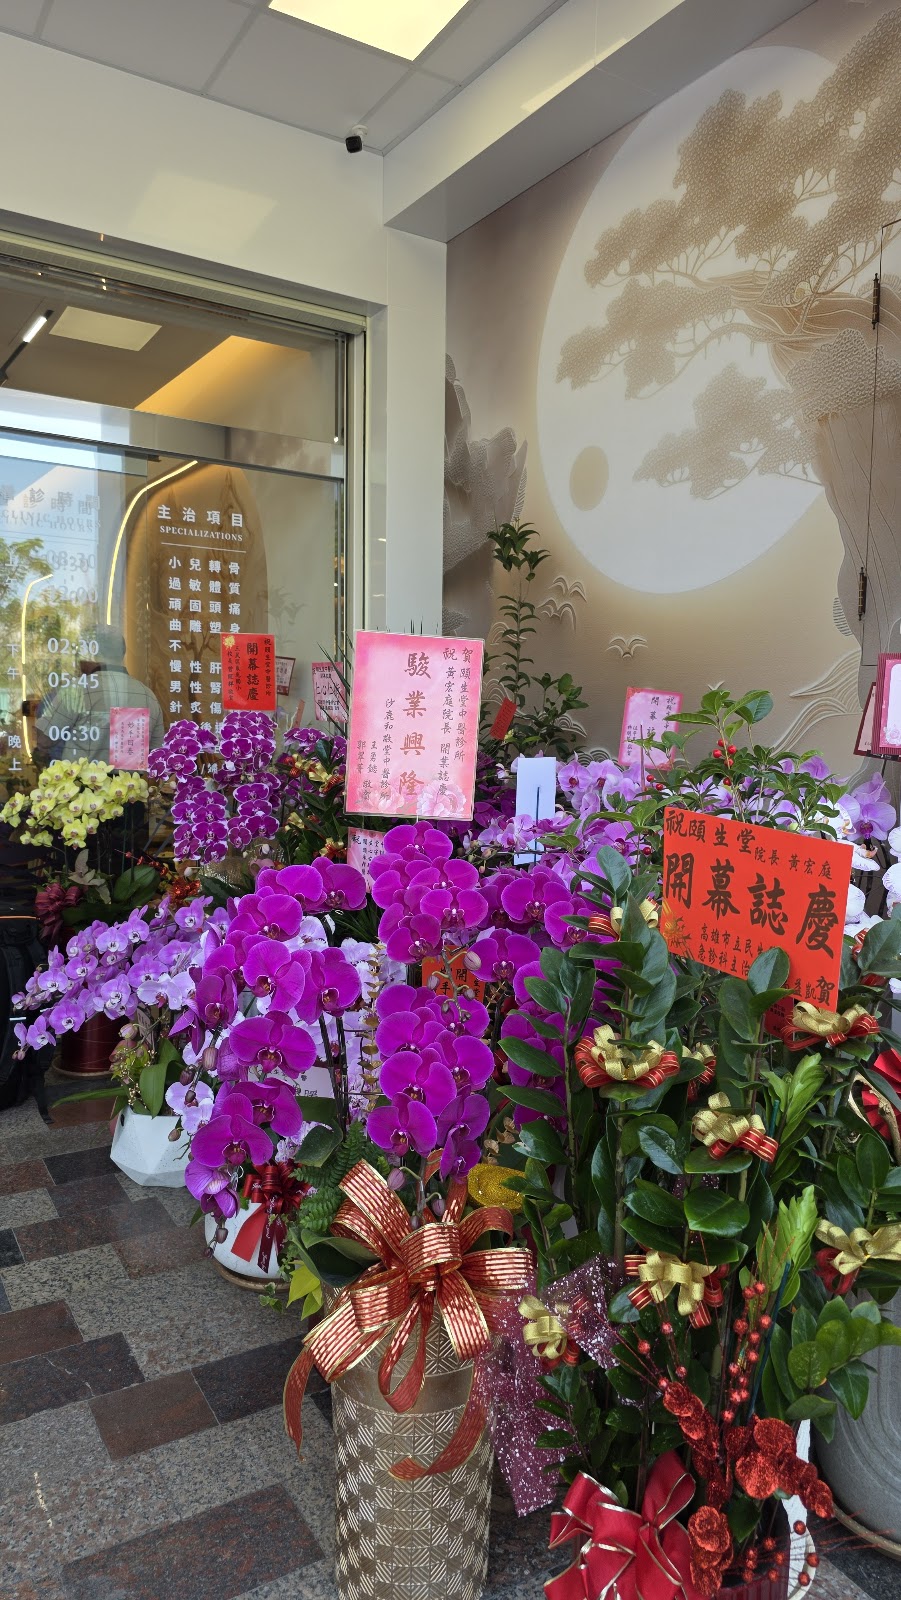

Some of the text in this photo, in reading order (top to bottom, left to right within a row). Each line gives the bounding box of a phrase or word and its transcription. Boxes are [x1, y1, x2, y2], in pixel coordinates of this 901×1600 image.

[157, 505, 243, 527] 主治項目
[160, 526, 243, 541] SPECIALIZATIONS
[169, 556, 240, 575] 小兒轉骨
[169, 577, 240, 595] 過敏體質
[169, 598, 240, 616] 頑固頭痛
[47, 638, 99, 655] 02:30
[6, 643, 20, 680] 下午
[246, 642, 260, 700] 開幕誌慶
[48, 672, 99, 689] 05:45
[48, 725, 100, 742] 06:30
[400, 652, 431, 796] 駿業興隆
[8, 735, 22, 771] 晚上
[666, 810, 755, 854] 祝頤生堂
[665, 853, 838, 959] 開幕誌慶
[701, 922, 775, 957] 高雄市立民生
